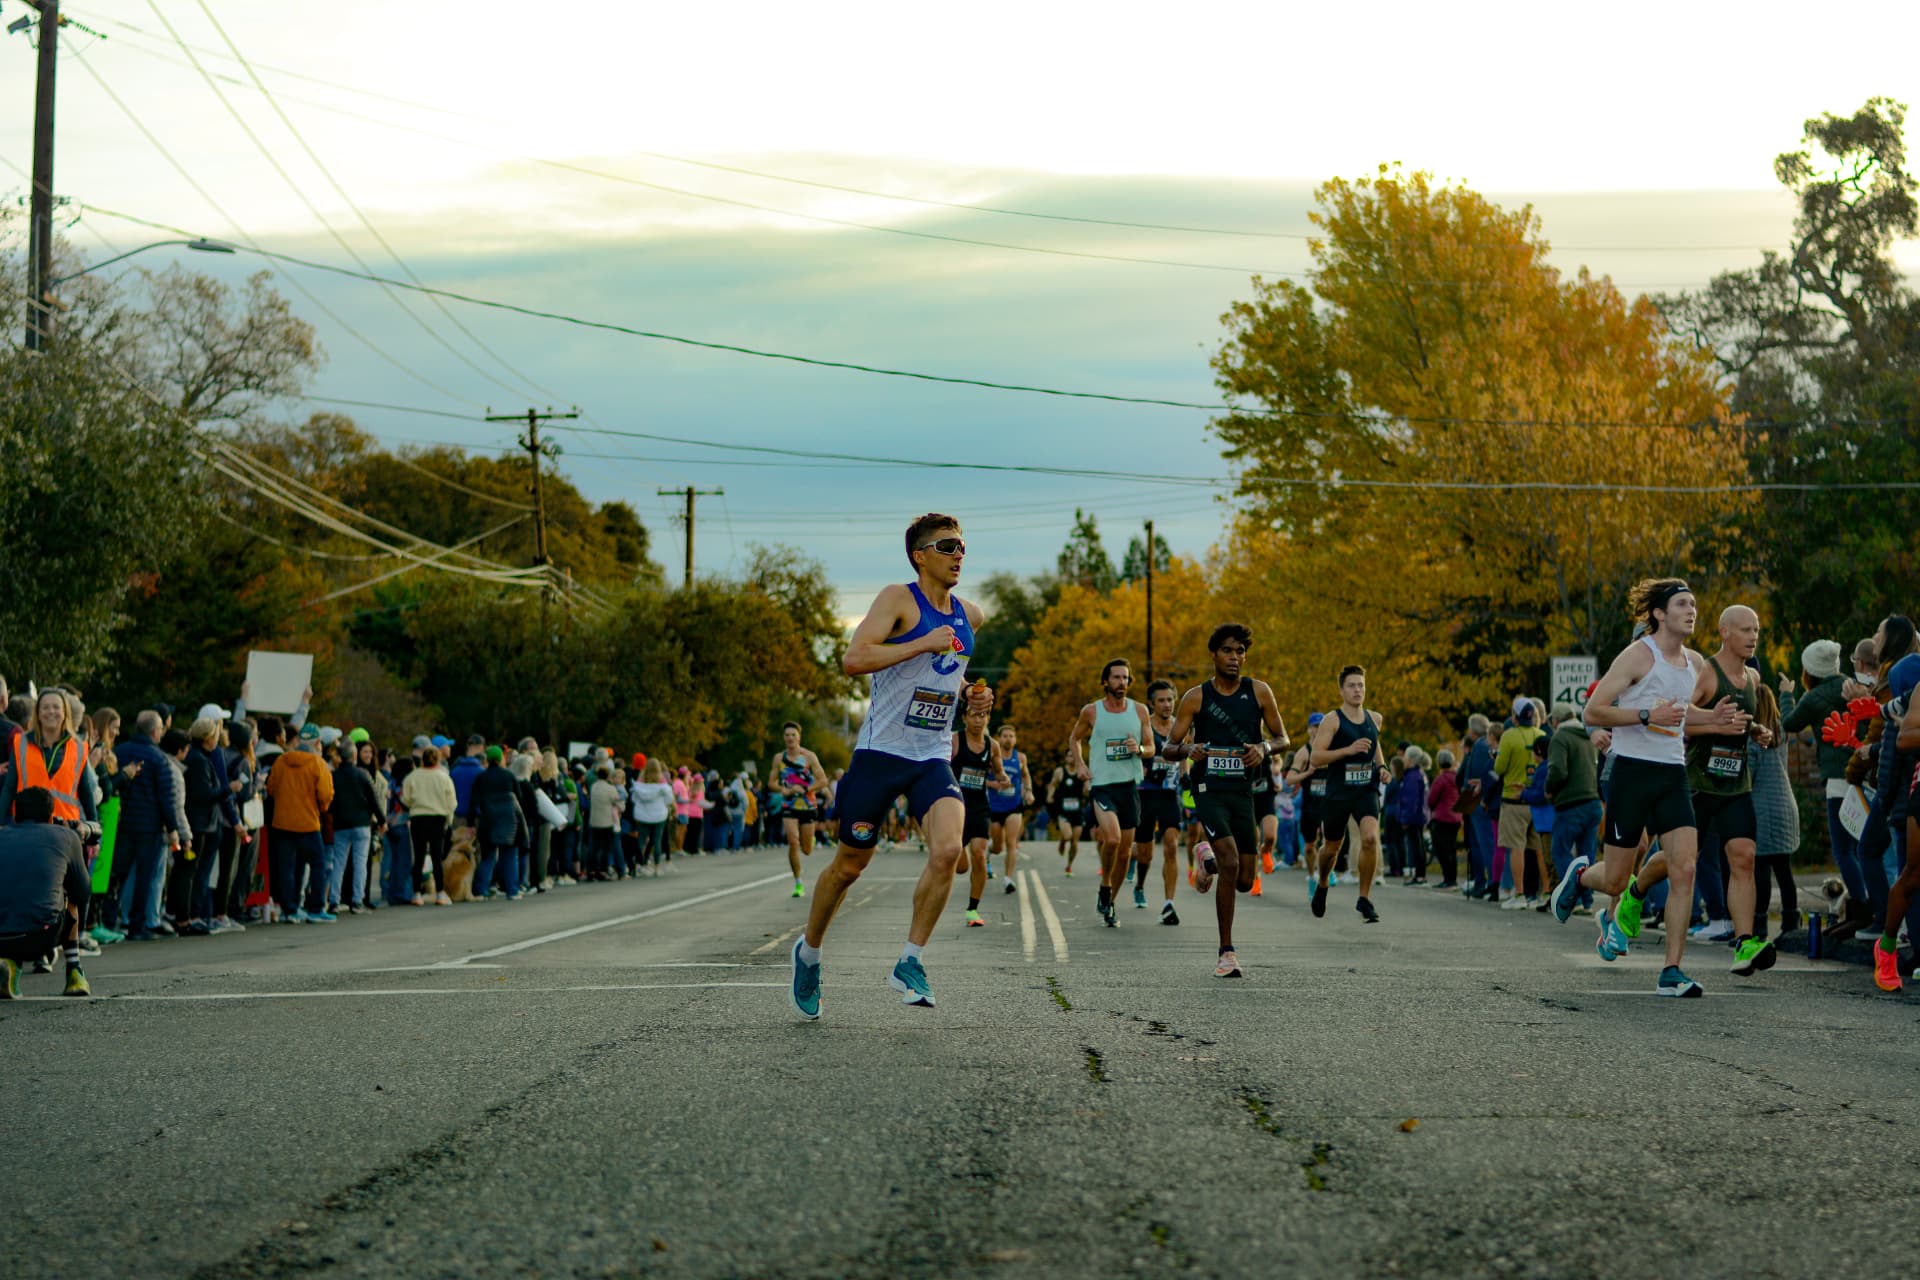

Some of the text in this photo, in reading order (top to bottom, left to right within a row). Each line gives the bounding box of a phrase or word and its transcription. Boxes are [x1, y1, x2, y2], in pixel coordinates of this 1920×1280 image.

[1556, 664, 1593, 672] SPEED
[1560, 675, 1587, 684] LIMIT
[916, 703, 947, 719] 2794
[1213, 758, 1240, 769] 9310
[1713, 758, 1738, 770] 9992
[1351, 771, 1369, 780] 1192
